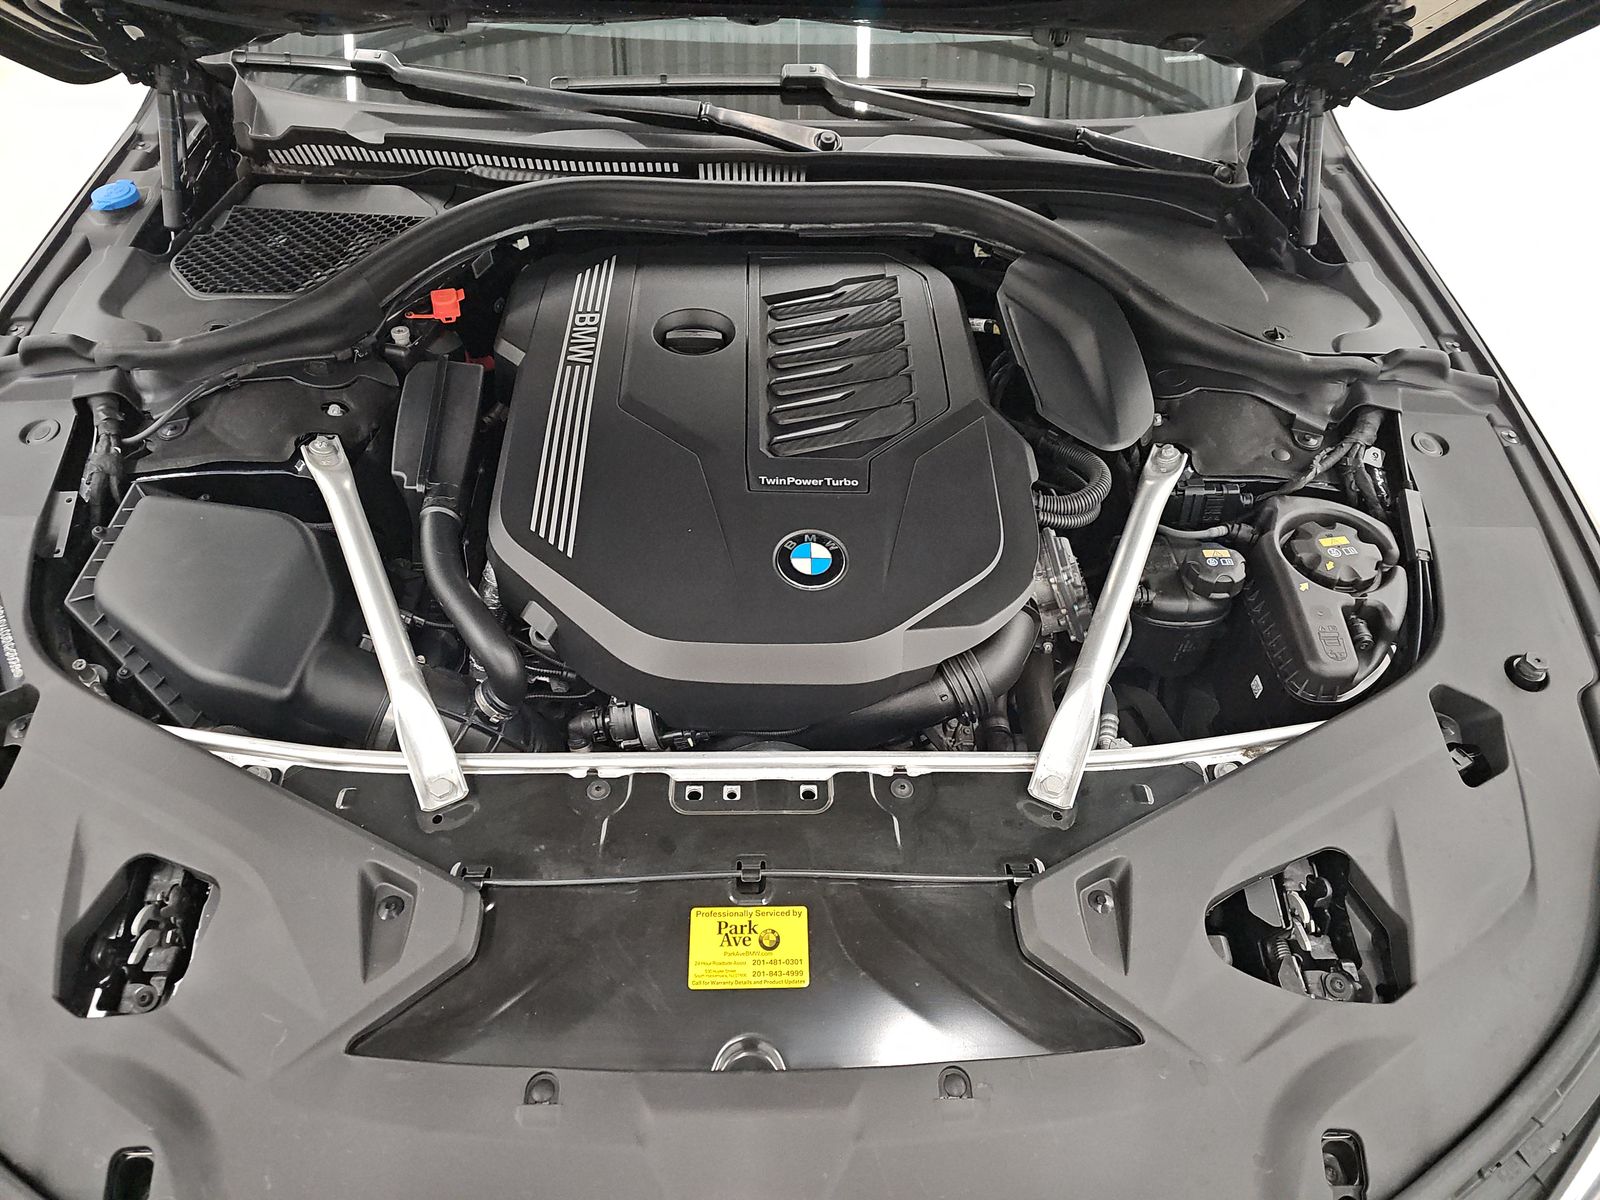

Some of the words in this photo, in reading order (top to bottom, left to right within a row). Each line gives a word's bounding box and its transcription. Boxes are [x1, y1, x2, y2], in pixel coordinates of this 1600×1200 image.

[566, 313, 600, 364] BMW
[759, 476, 823, 486] TwinPower
[824, 477, 859, 486] Turbo
[783, 534, 839, 551] BMW
[695, 910, 753, 918] Professionally
[755, 909, 791, 917] Serviced
[792, 909, 802, 918] by
[717, 920, 758, 935] Park
[719, 933, 752, 947] Ave
